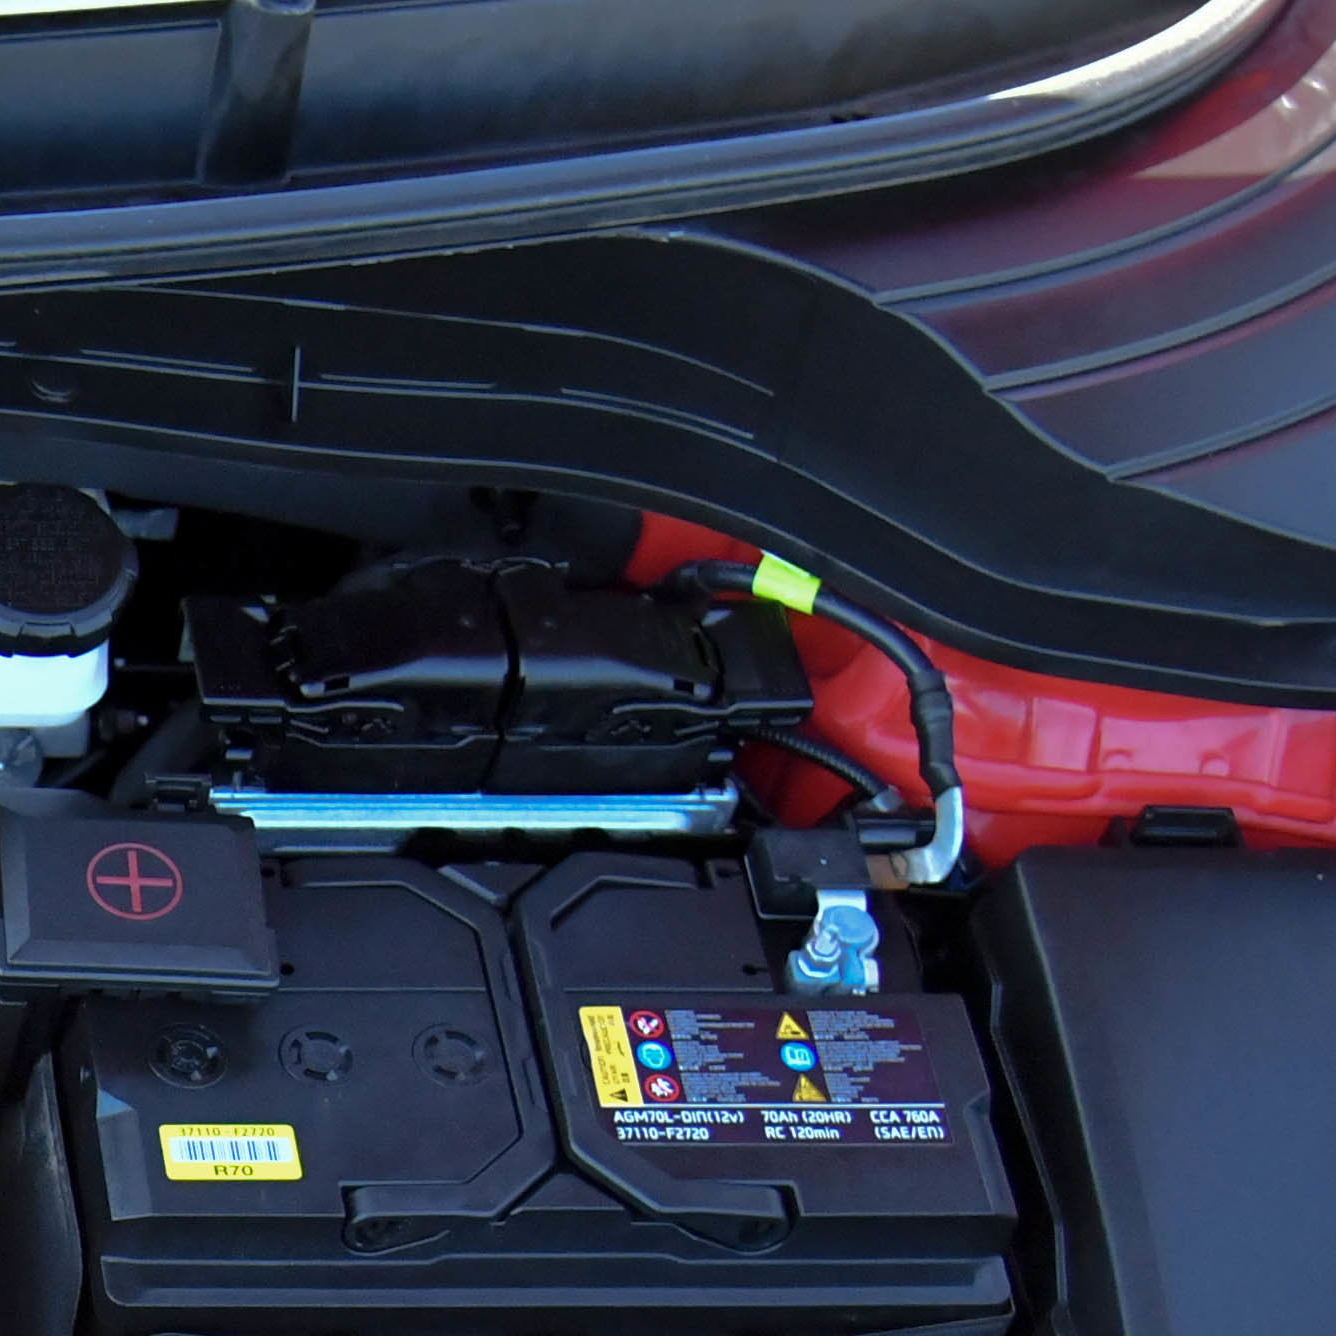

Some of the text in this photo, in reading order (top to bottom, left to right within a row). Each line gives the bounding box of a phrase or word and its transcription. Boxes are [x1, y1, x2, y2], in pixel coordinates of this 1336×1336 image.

[760, 1110, 799, 1124] 70Ah
[869, 1110, 901, 1124] CCA
[616, 1126, 711, 1141] 37110-F2720
[764, 1126, 841, 1140] RC 120min
[213, 1164, 254, 1176] R70
